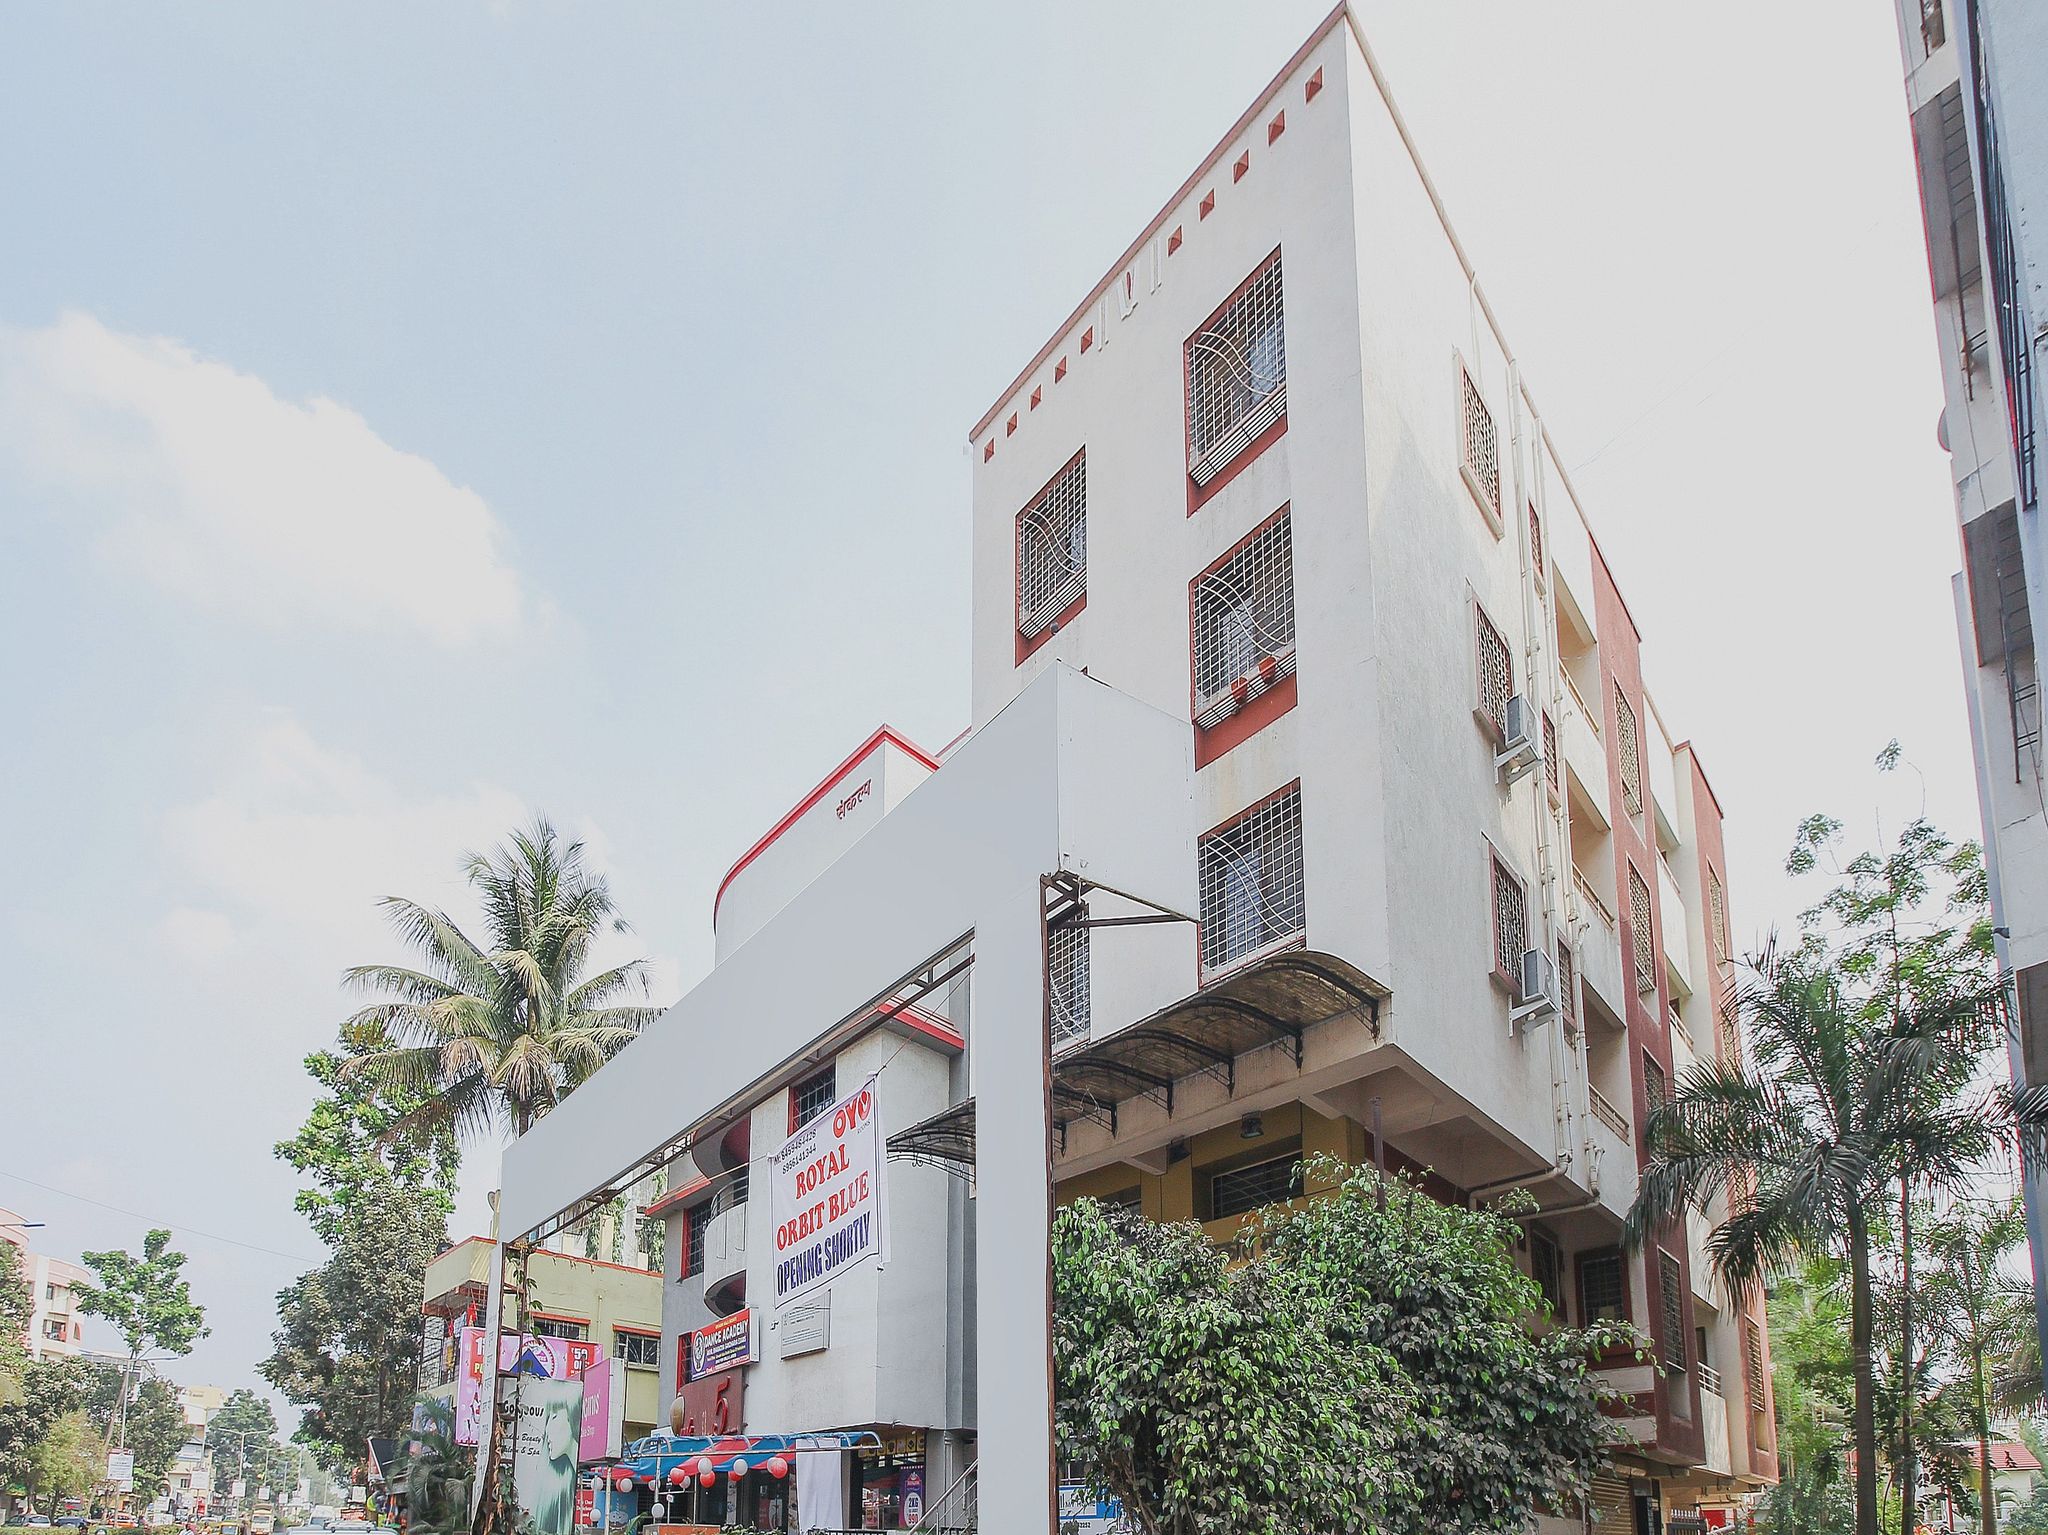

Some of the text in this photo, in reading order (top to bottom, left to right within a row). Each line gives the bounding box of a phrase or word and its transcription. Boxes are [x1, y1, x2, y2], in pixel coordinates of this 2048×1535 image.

[832, 1090, 872, 1138] OYO
[795, 1143, 850, 1200] ROYAL
[776, 1170, 870, 1251] ORBIT BLUE
[777, 1210, 871, 1297] OPENING SHORTLY
[704, 1330, 722, 1349] DANCE
[722, 1319, 749, 1342] ACADEMY
[503, 1399, 545, 1419] Gogeous
[521, 1432, 542, 1444] Beauty
[527, 1447, 541, 1456] Spa
